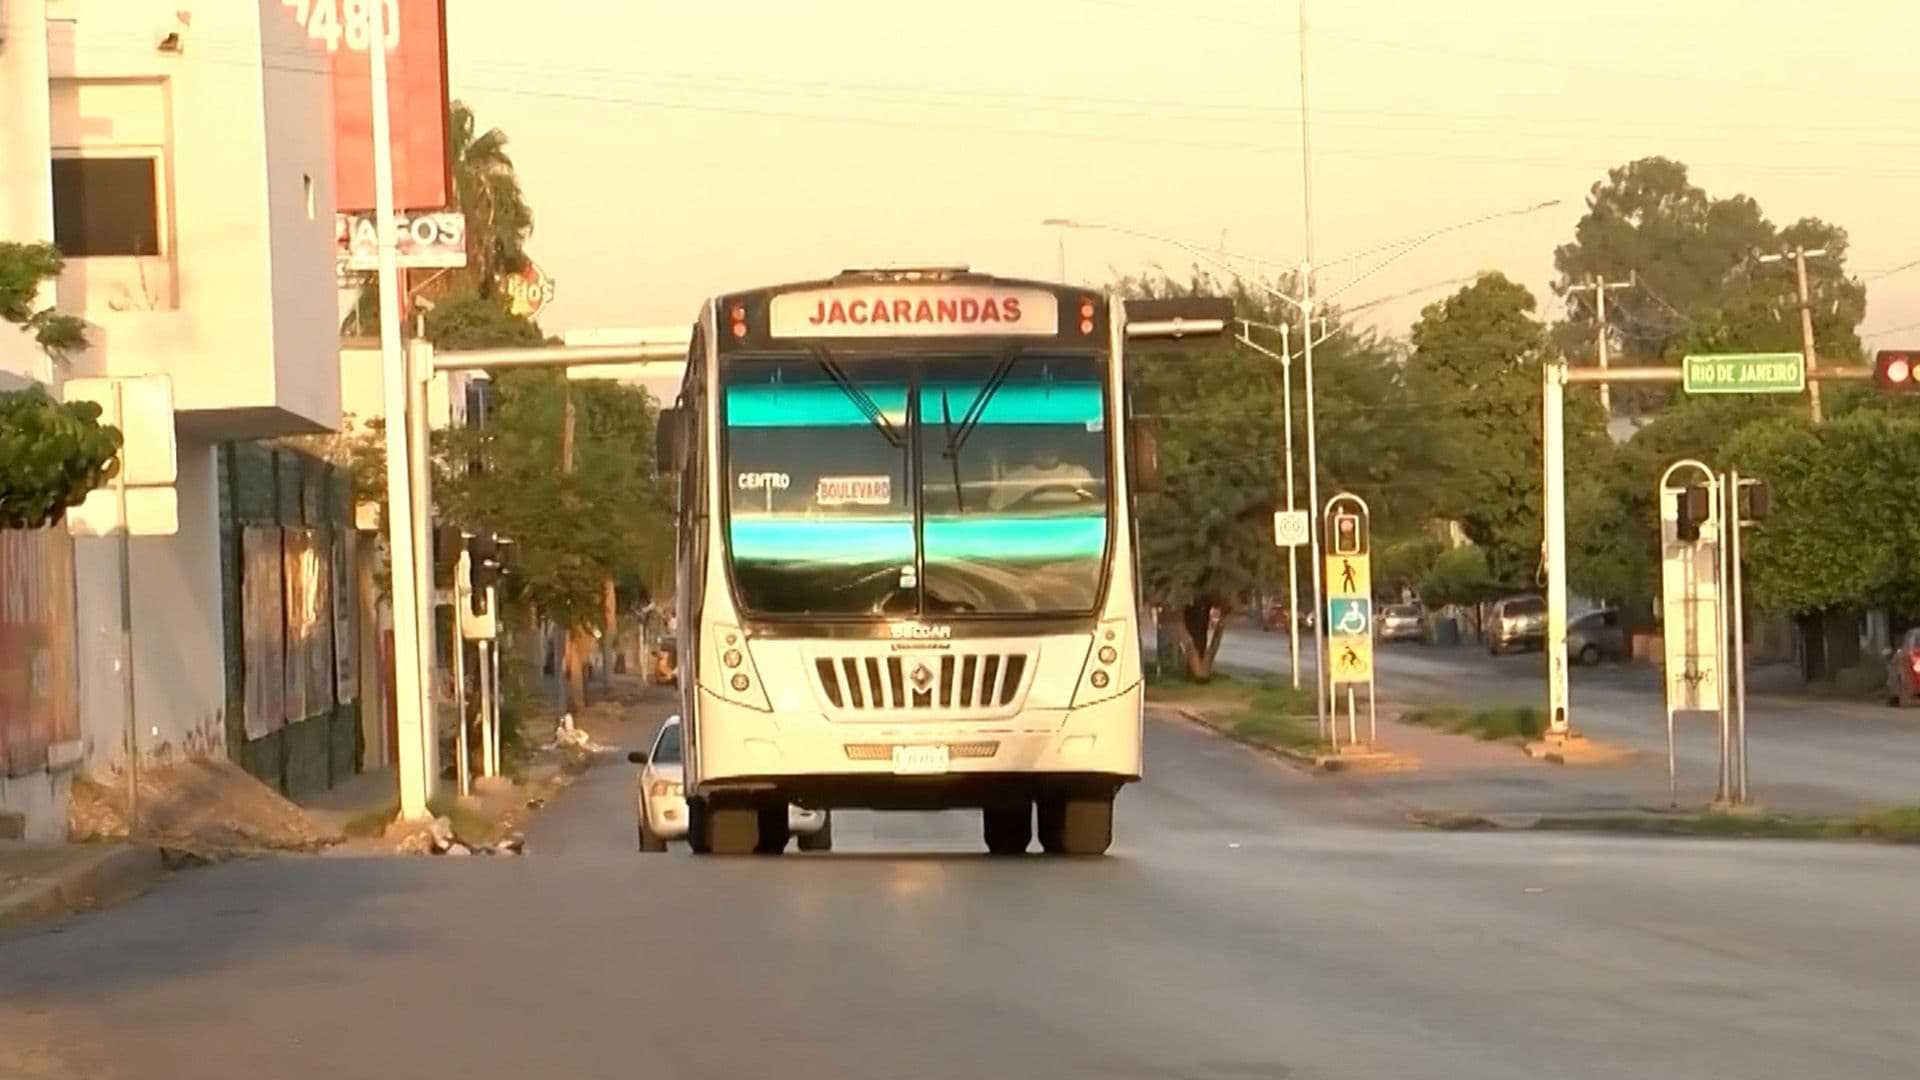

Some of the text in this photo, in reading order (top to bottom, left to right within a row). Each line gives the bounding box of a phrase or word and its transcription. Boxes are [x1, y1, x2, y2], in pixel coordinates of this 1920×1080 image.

[808, 297, 1023, 325] JACARANDAS
[1691, 361, 1798, 384] RIO DE JANEIRO
[738, 472, 790, 489] CENTRO
[820, 480, 889, 500] BOULEVARD
